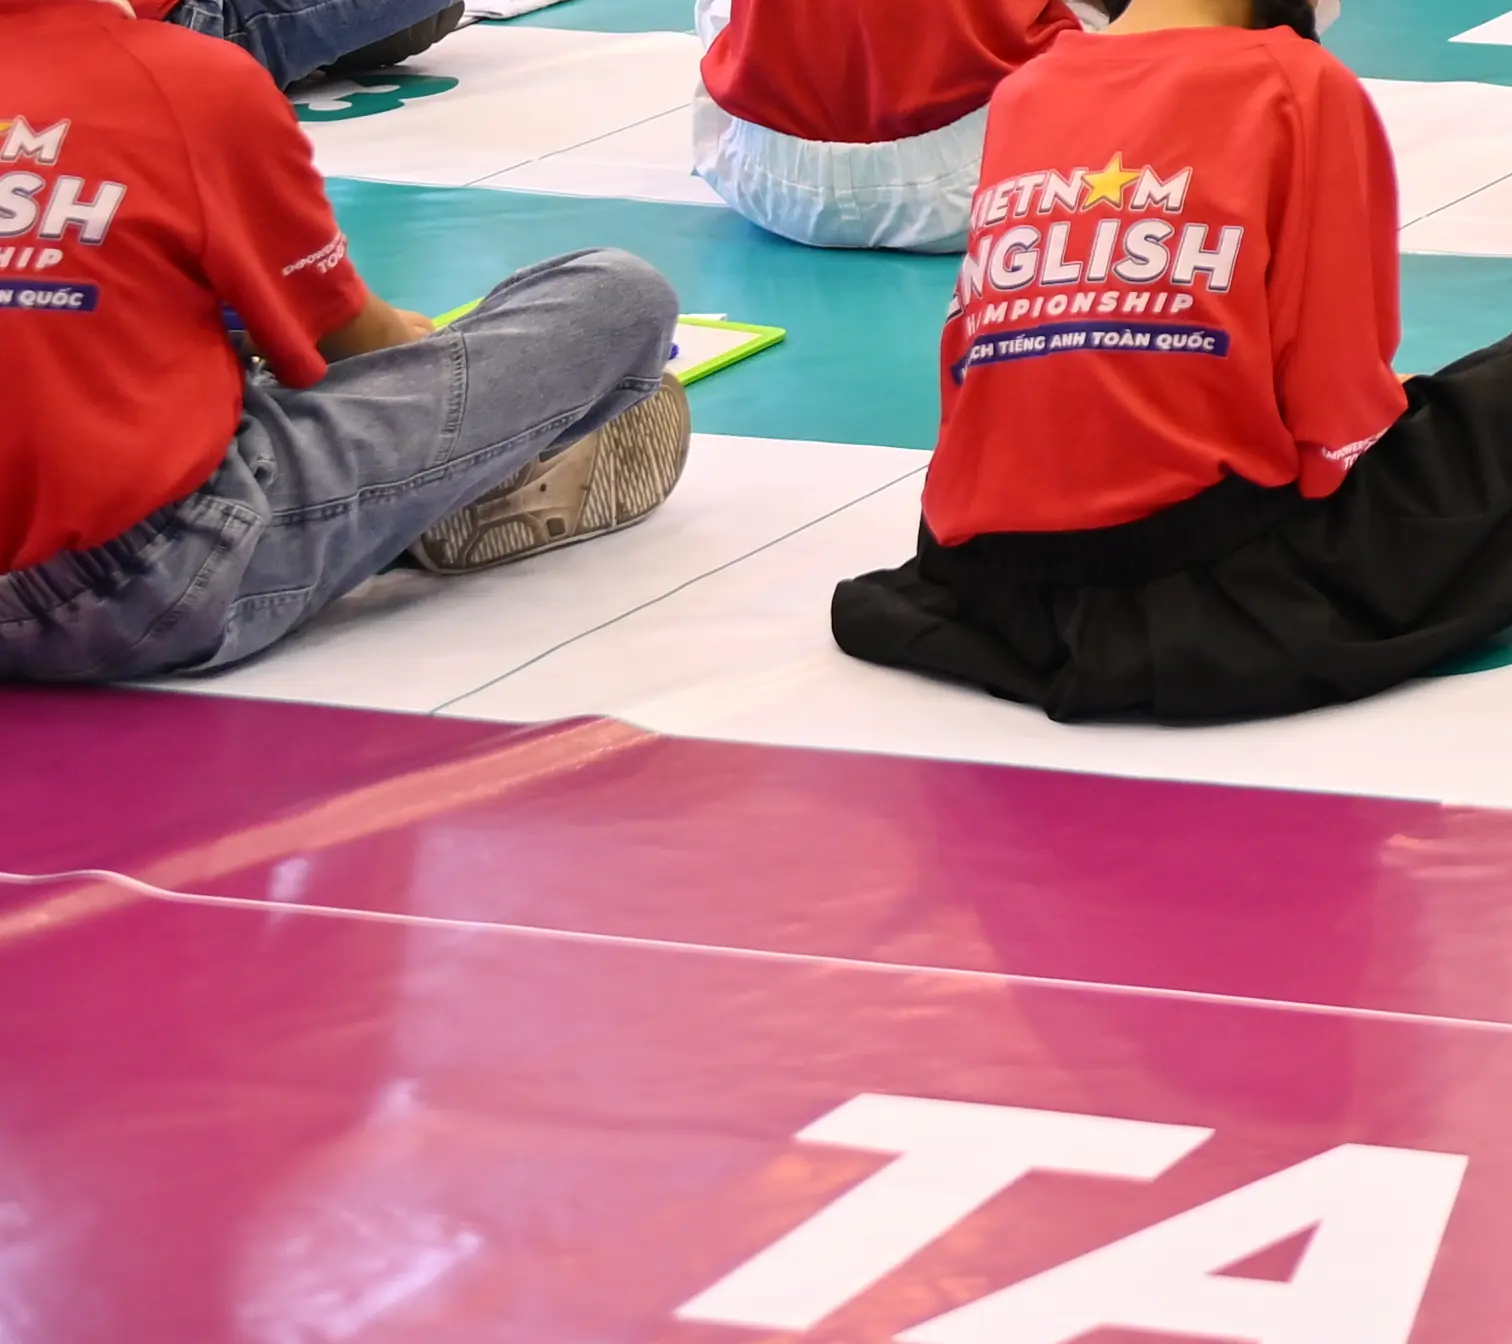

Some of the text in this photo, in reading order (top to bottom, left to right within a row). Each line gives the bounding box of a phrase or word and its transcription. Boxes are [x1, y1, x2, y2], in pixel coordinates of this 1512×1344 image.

[952, 220, 1245, 315] NGLISH
[20, 282, 86, 305] QUỐC
[999, 323, 1215, 355] TIẾNG ANH TOÀN QUỐC
